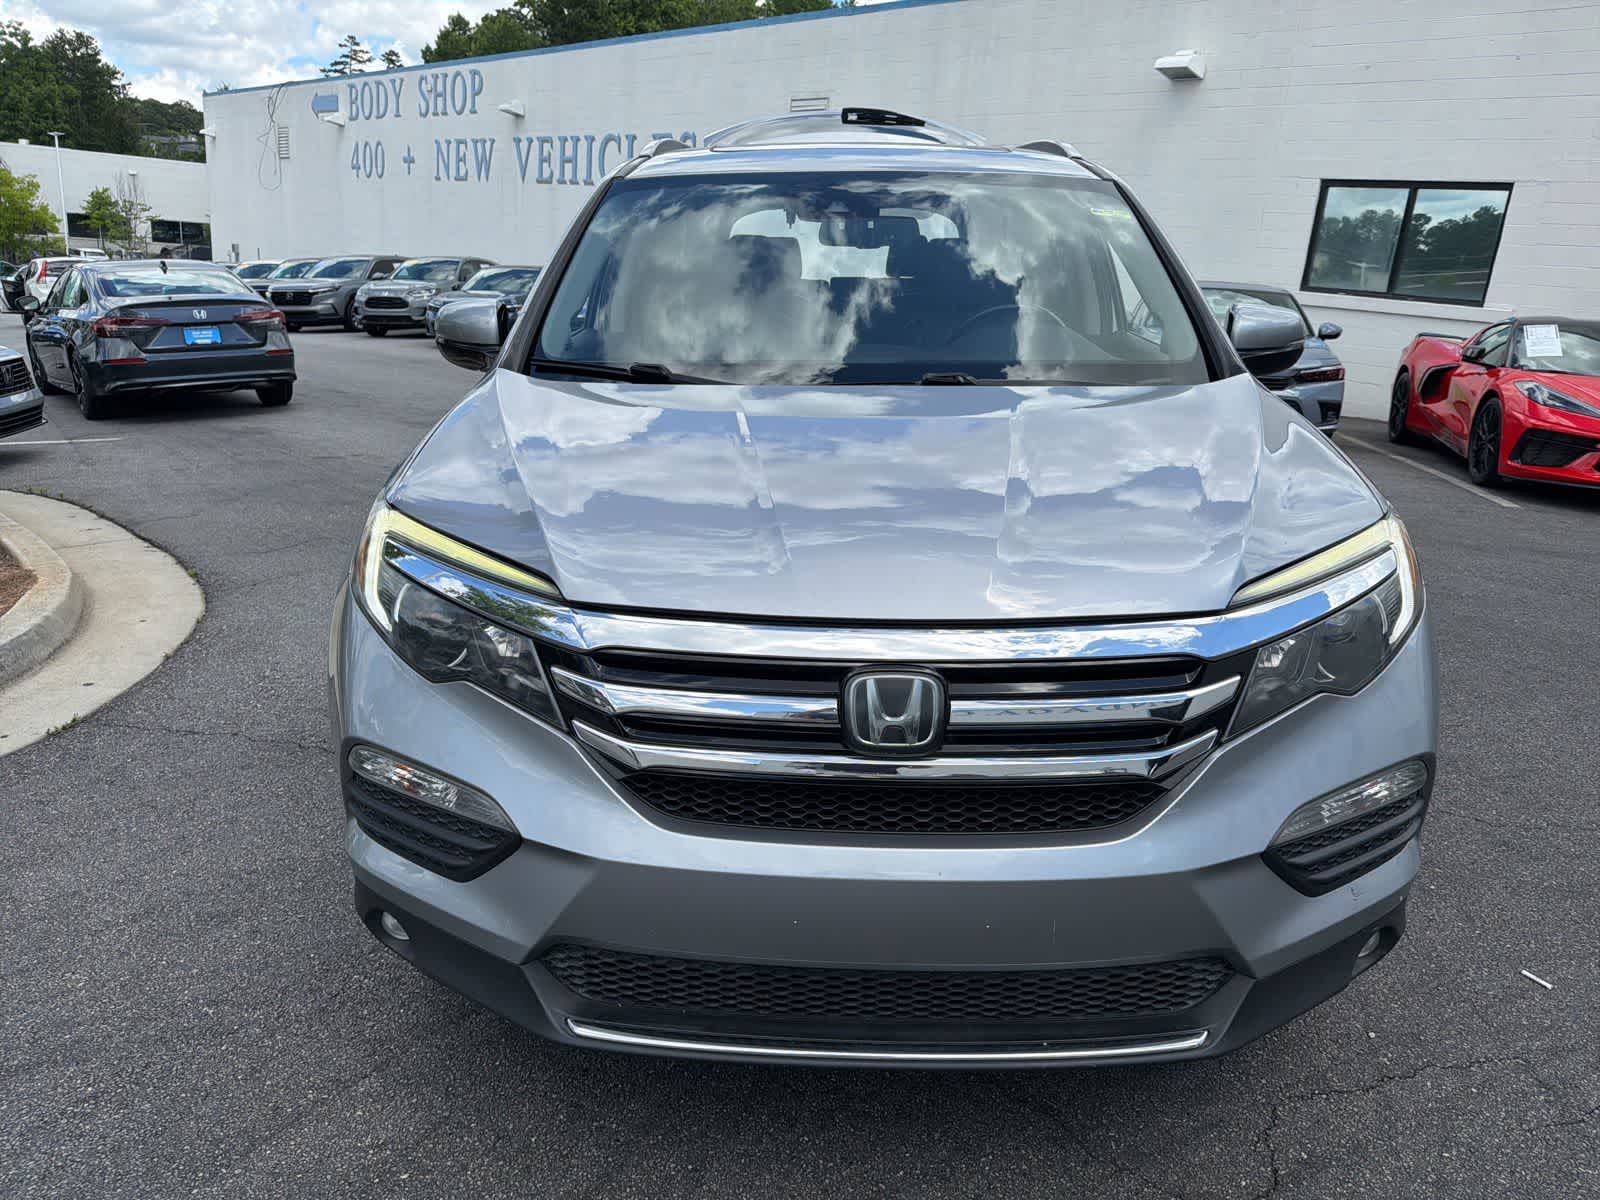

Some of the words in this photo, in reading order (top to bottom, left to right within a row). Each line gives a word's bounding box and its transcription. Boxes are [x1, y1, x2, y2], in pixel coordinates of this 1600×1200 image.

[348, 78, 404, 121] BODY
[418, 69, 484, 118] SHOP
[351, 141, 385, 179] 400
[402, 144, 415, 176] +
[434, 138, 496, 182] NEW
[513, 131, 697, 186] VEHIC
